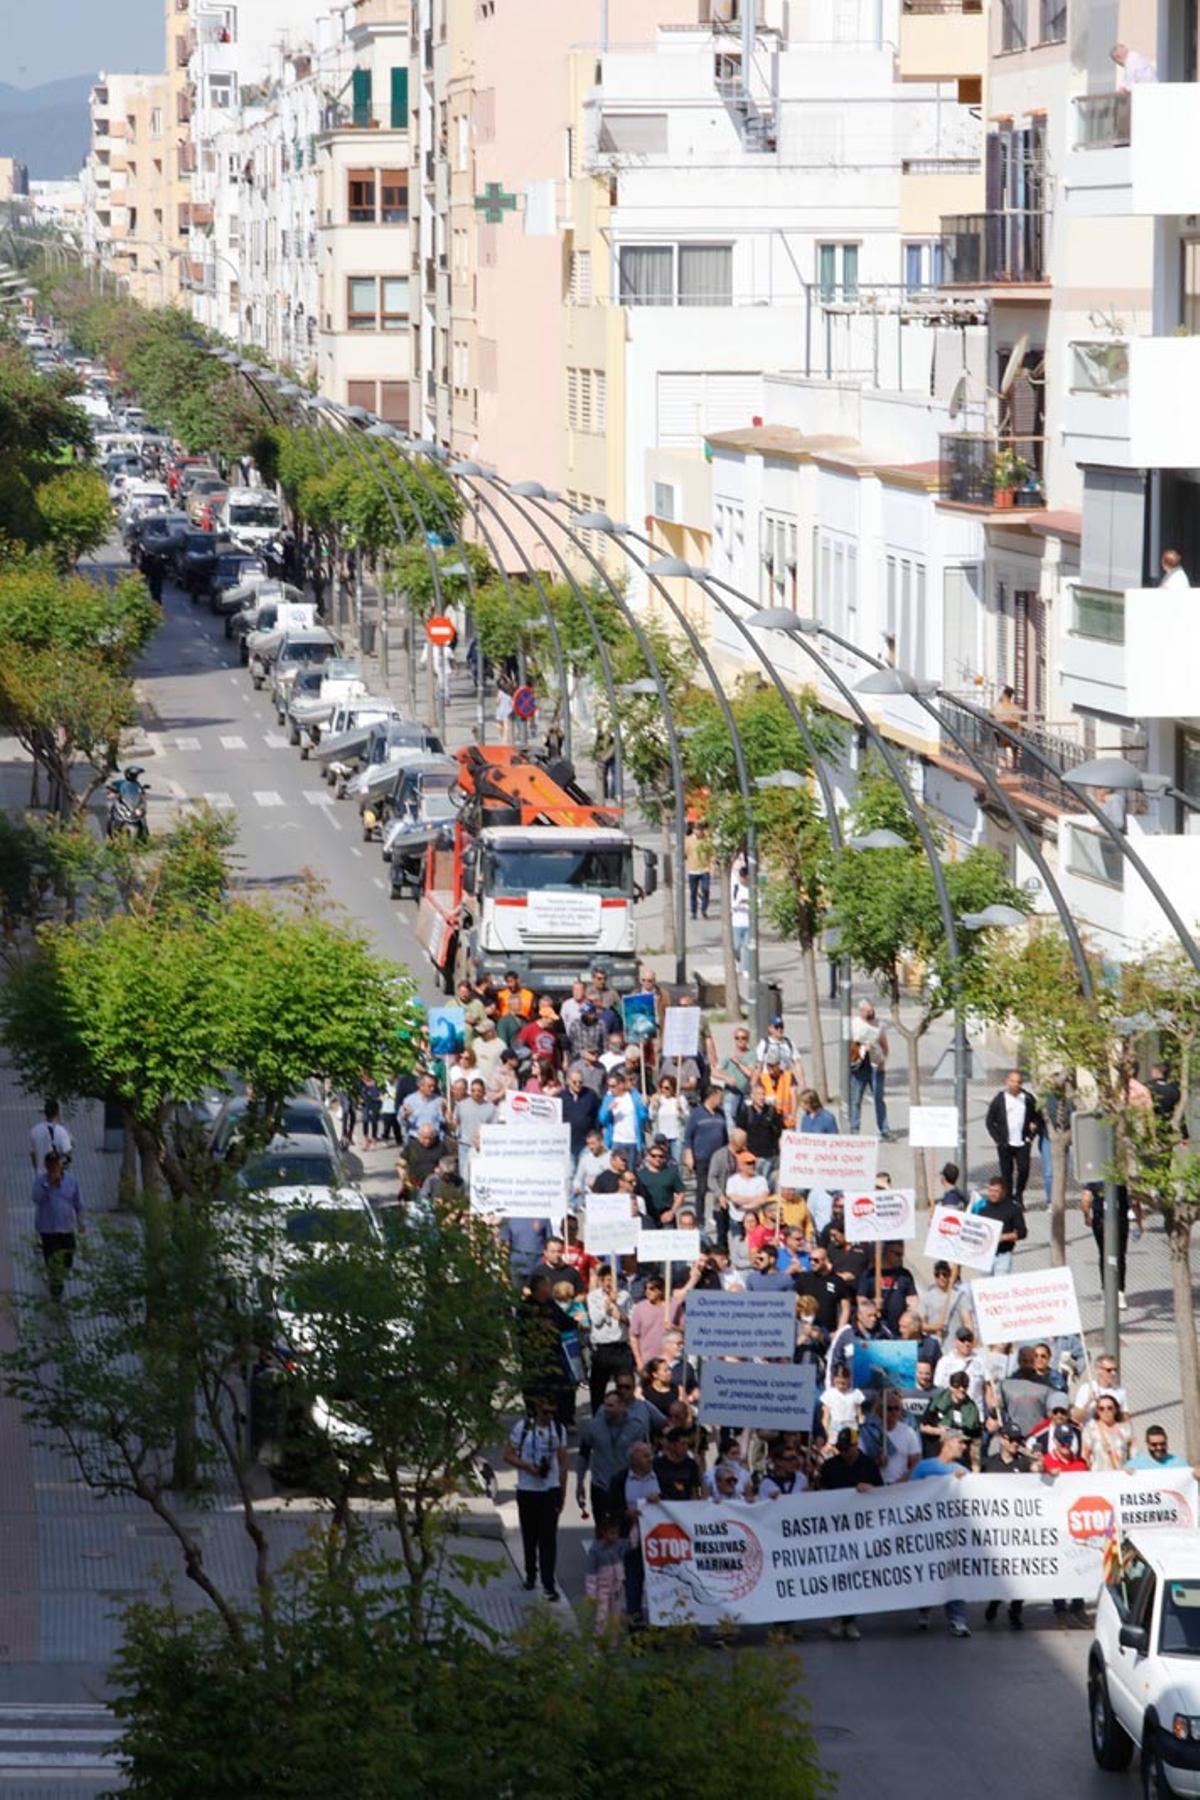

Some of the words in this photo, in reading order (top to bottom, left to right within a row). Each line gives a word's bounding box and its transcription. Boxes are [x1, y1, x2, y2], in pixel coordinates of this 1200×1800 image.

[714, 1374, 769, 1387] Queremos
[730, 1388, 775, 1400] pescado
[1119, 1492, 1161, 1506] FALSAS
[781, 1515, 828, 1538] BASTA
[830, 1512, 850, 1532] YA
[854, 1511, 874, 1530] DE
[878, 1502, 932, 1527] FALSAS
[935, 1498, 1009, 1520] RESERVAS
[1013, 1498, 1043, 1518] QUE
[1121, 1508, 1178, 1525] RESERVAS
[646, 1537, 690, 1559] STOP
[771, 1541, 860, 1570] PRIVATIZAN
[863, 1537, 892, 1560] LOS
[970, 1527, 1058, 1547] NATURALES
[775, 1578, 797, 1599] DE
[799, 1574, 829, 1597] LOS
[831, 1564, 912, 1592] IBICENCOS
[914, 1563, 924, 1583] Y
